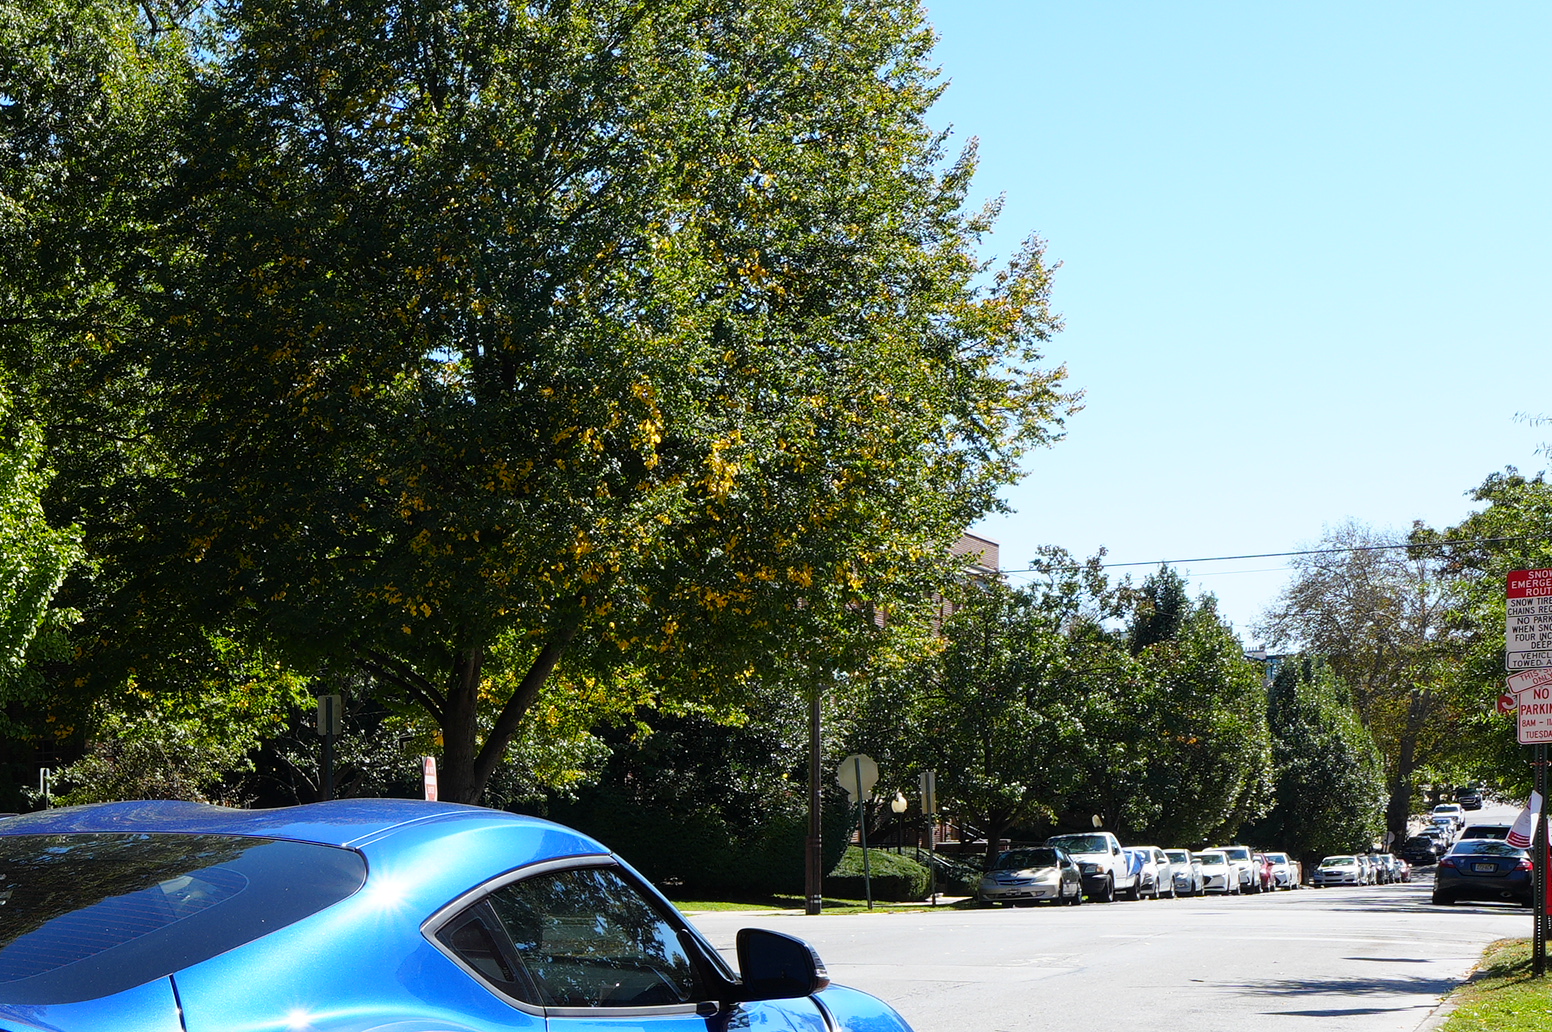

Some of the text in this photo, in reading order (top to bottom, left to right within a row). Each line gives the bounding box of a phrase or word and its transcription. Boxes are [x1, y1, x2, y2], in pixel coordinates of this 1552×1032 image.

[1510, 599, 1534, 607] SNOW
[1508, 607, 1535, 615] CHAINS
[1517, 616, 1530, 624] NO
[1512, 625, 1535, 633] WHEN
[1531, 640, 1552, 649] DEEP
[1513, 659, 1541, 667] TOWED
[1520, 669, 1539, 681] THIS
[1533, 688, 1549, 700] NO
[1522, 719, 1536, 728] 8AM
